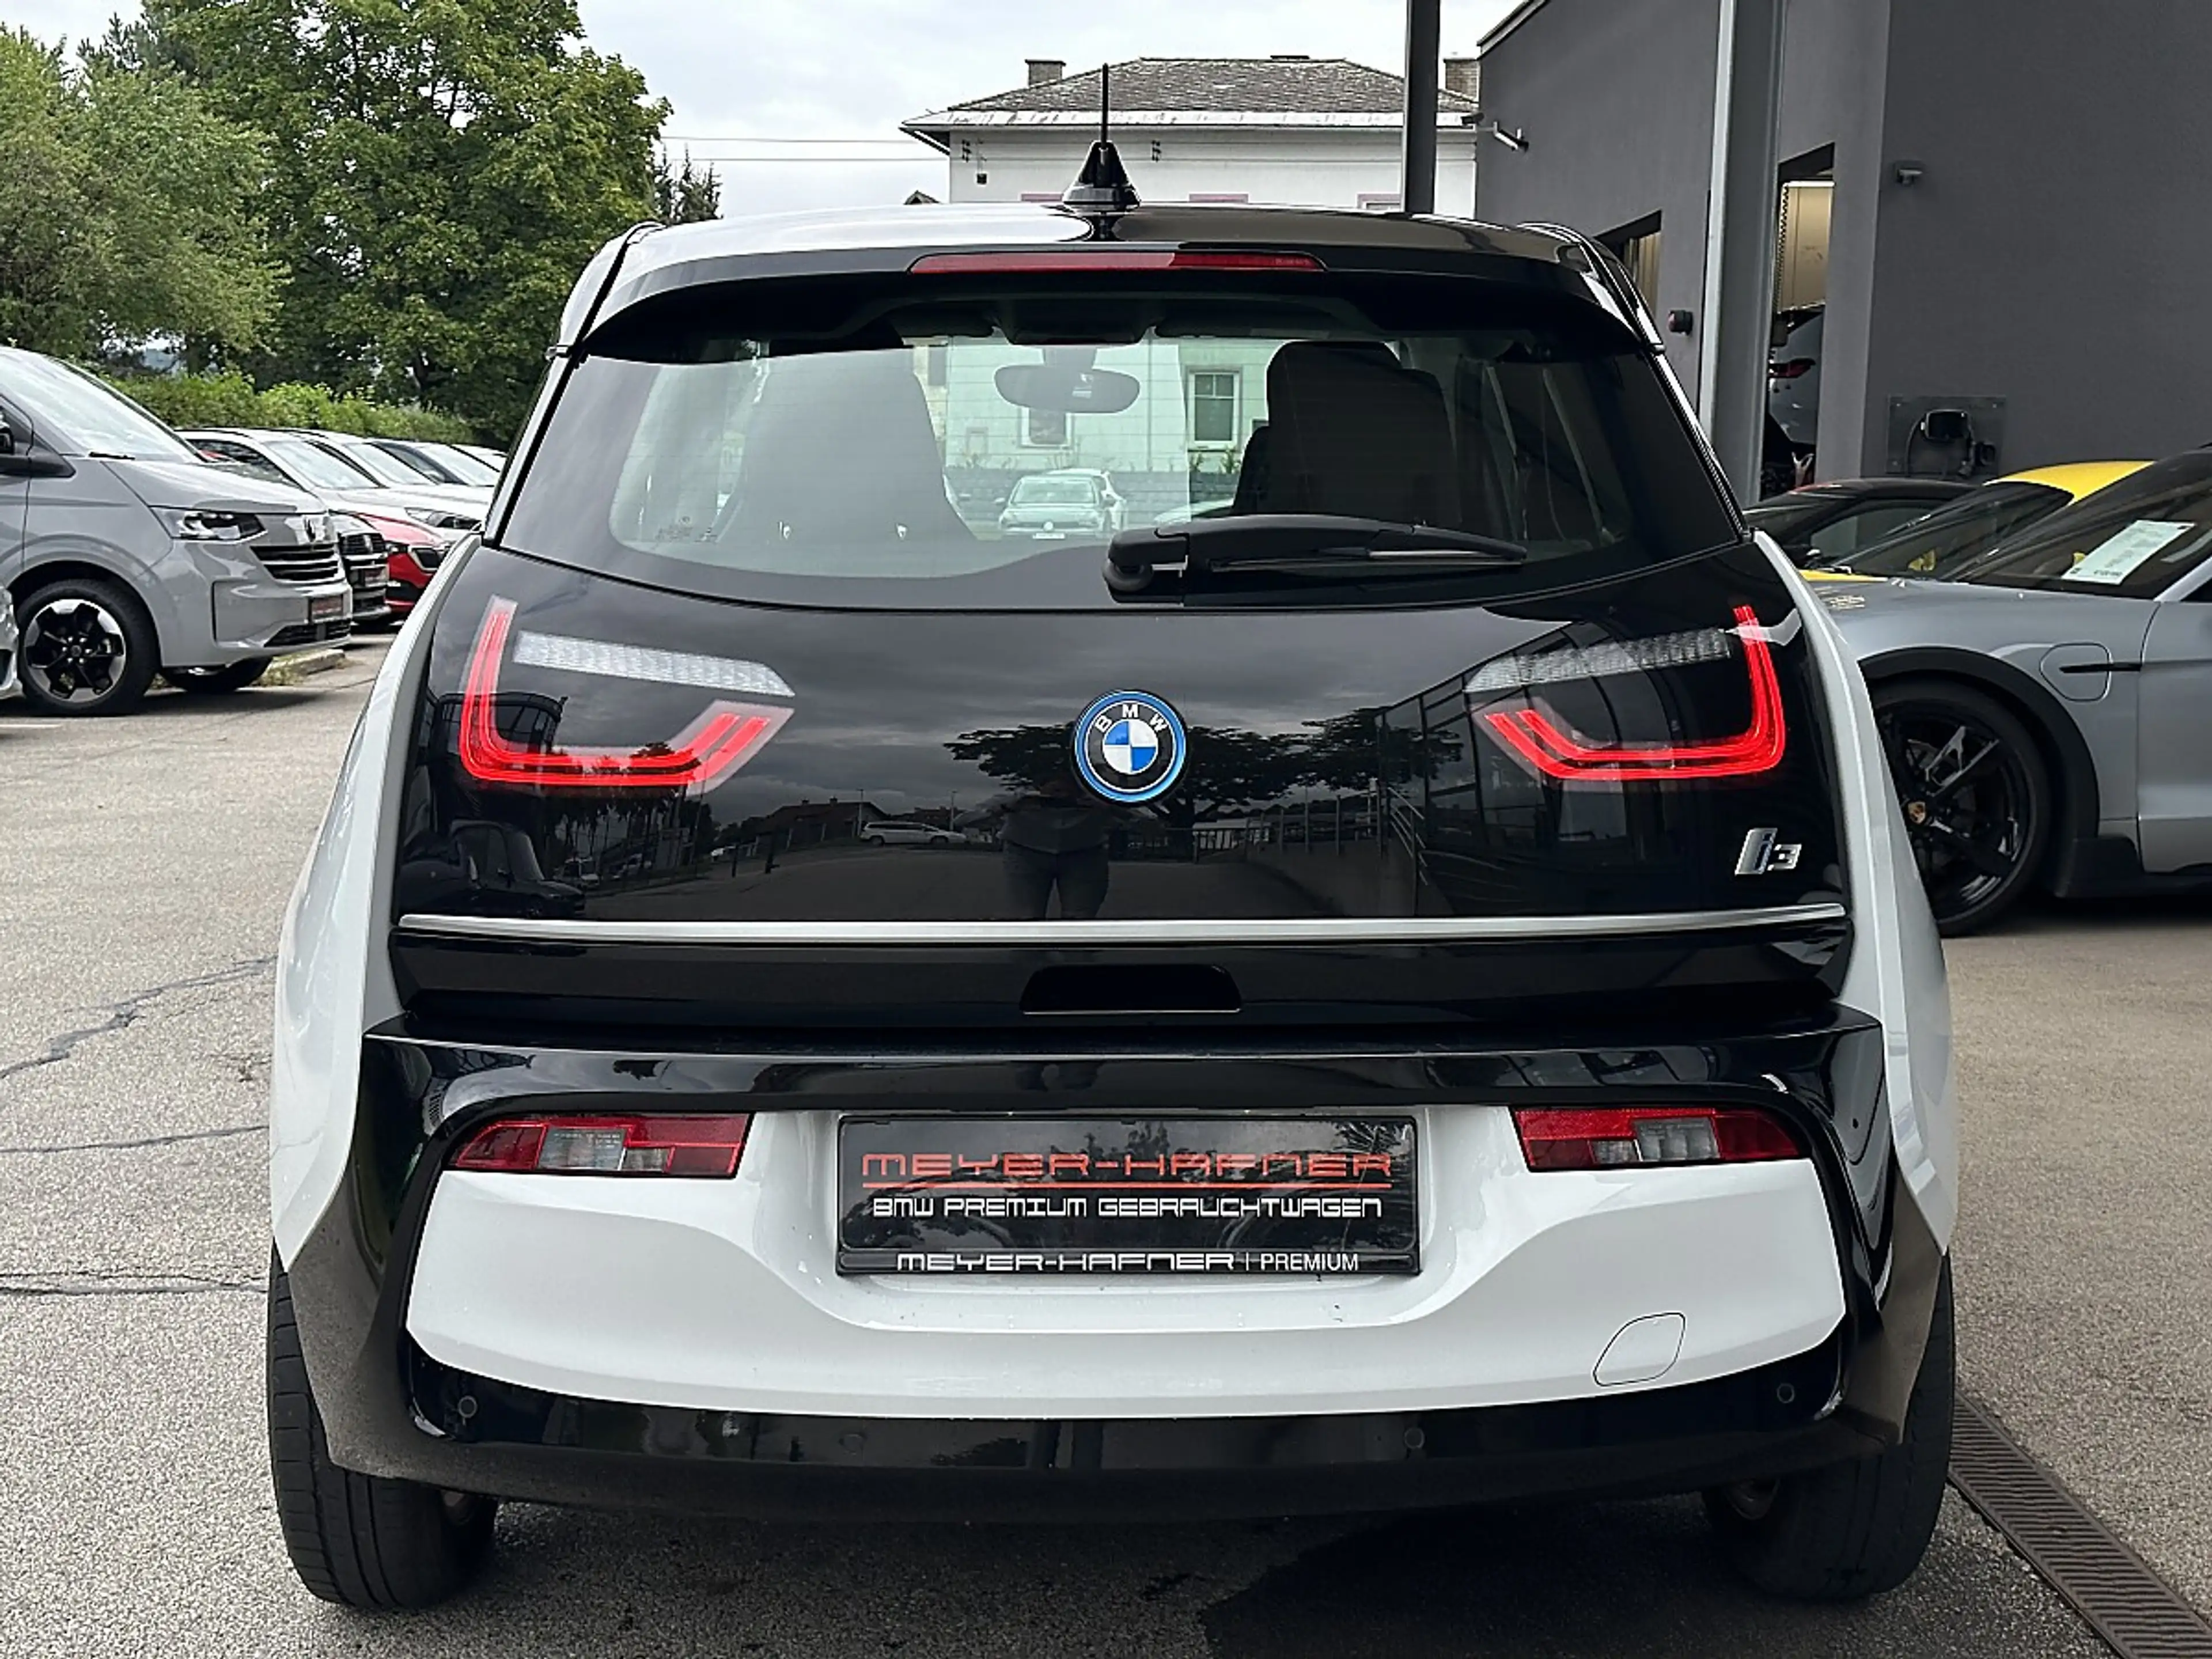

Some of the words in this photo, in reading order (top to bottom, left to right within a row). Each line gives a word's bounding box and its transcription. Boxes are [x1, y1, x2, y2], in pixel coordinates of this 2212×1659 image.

[1094, 703, 1168, 733] BMW
[1734, 828, 1802, 875] i3
[862, 1153, 1392, 1177] MEYER-HAFNER
[873, 1198, 934, 1218] BMW
[944, 1198, 1087, 1218] PREMIUM
[1098, 1198, 1382, 1218] GEBRAUCHTWAGEN
[897, 1253, 1234, 1271] MEYER-HAFNER
[1260, 1252, 1359, 1271] PREMIUM
